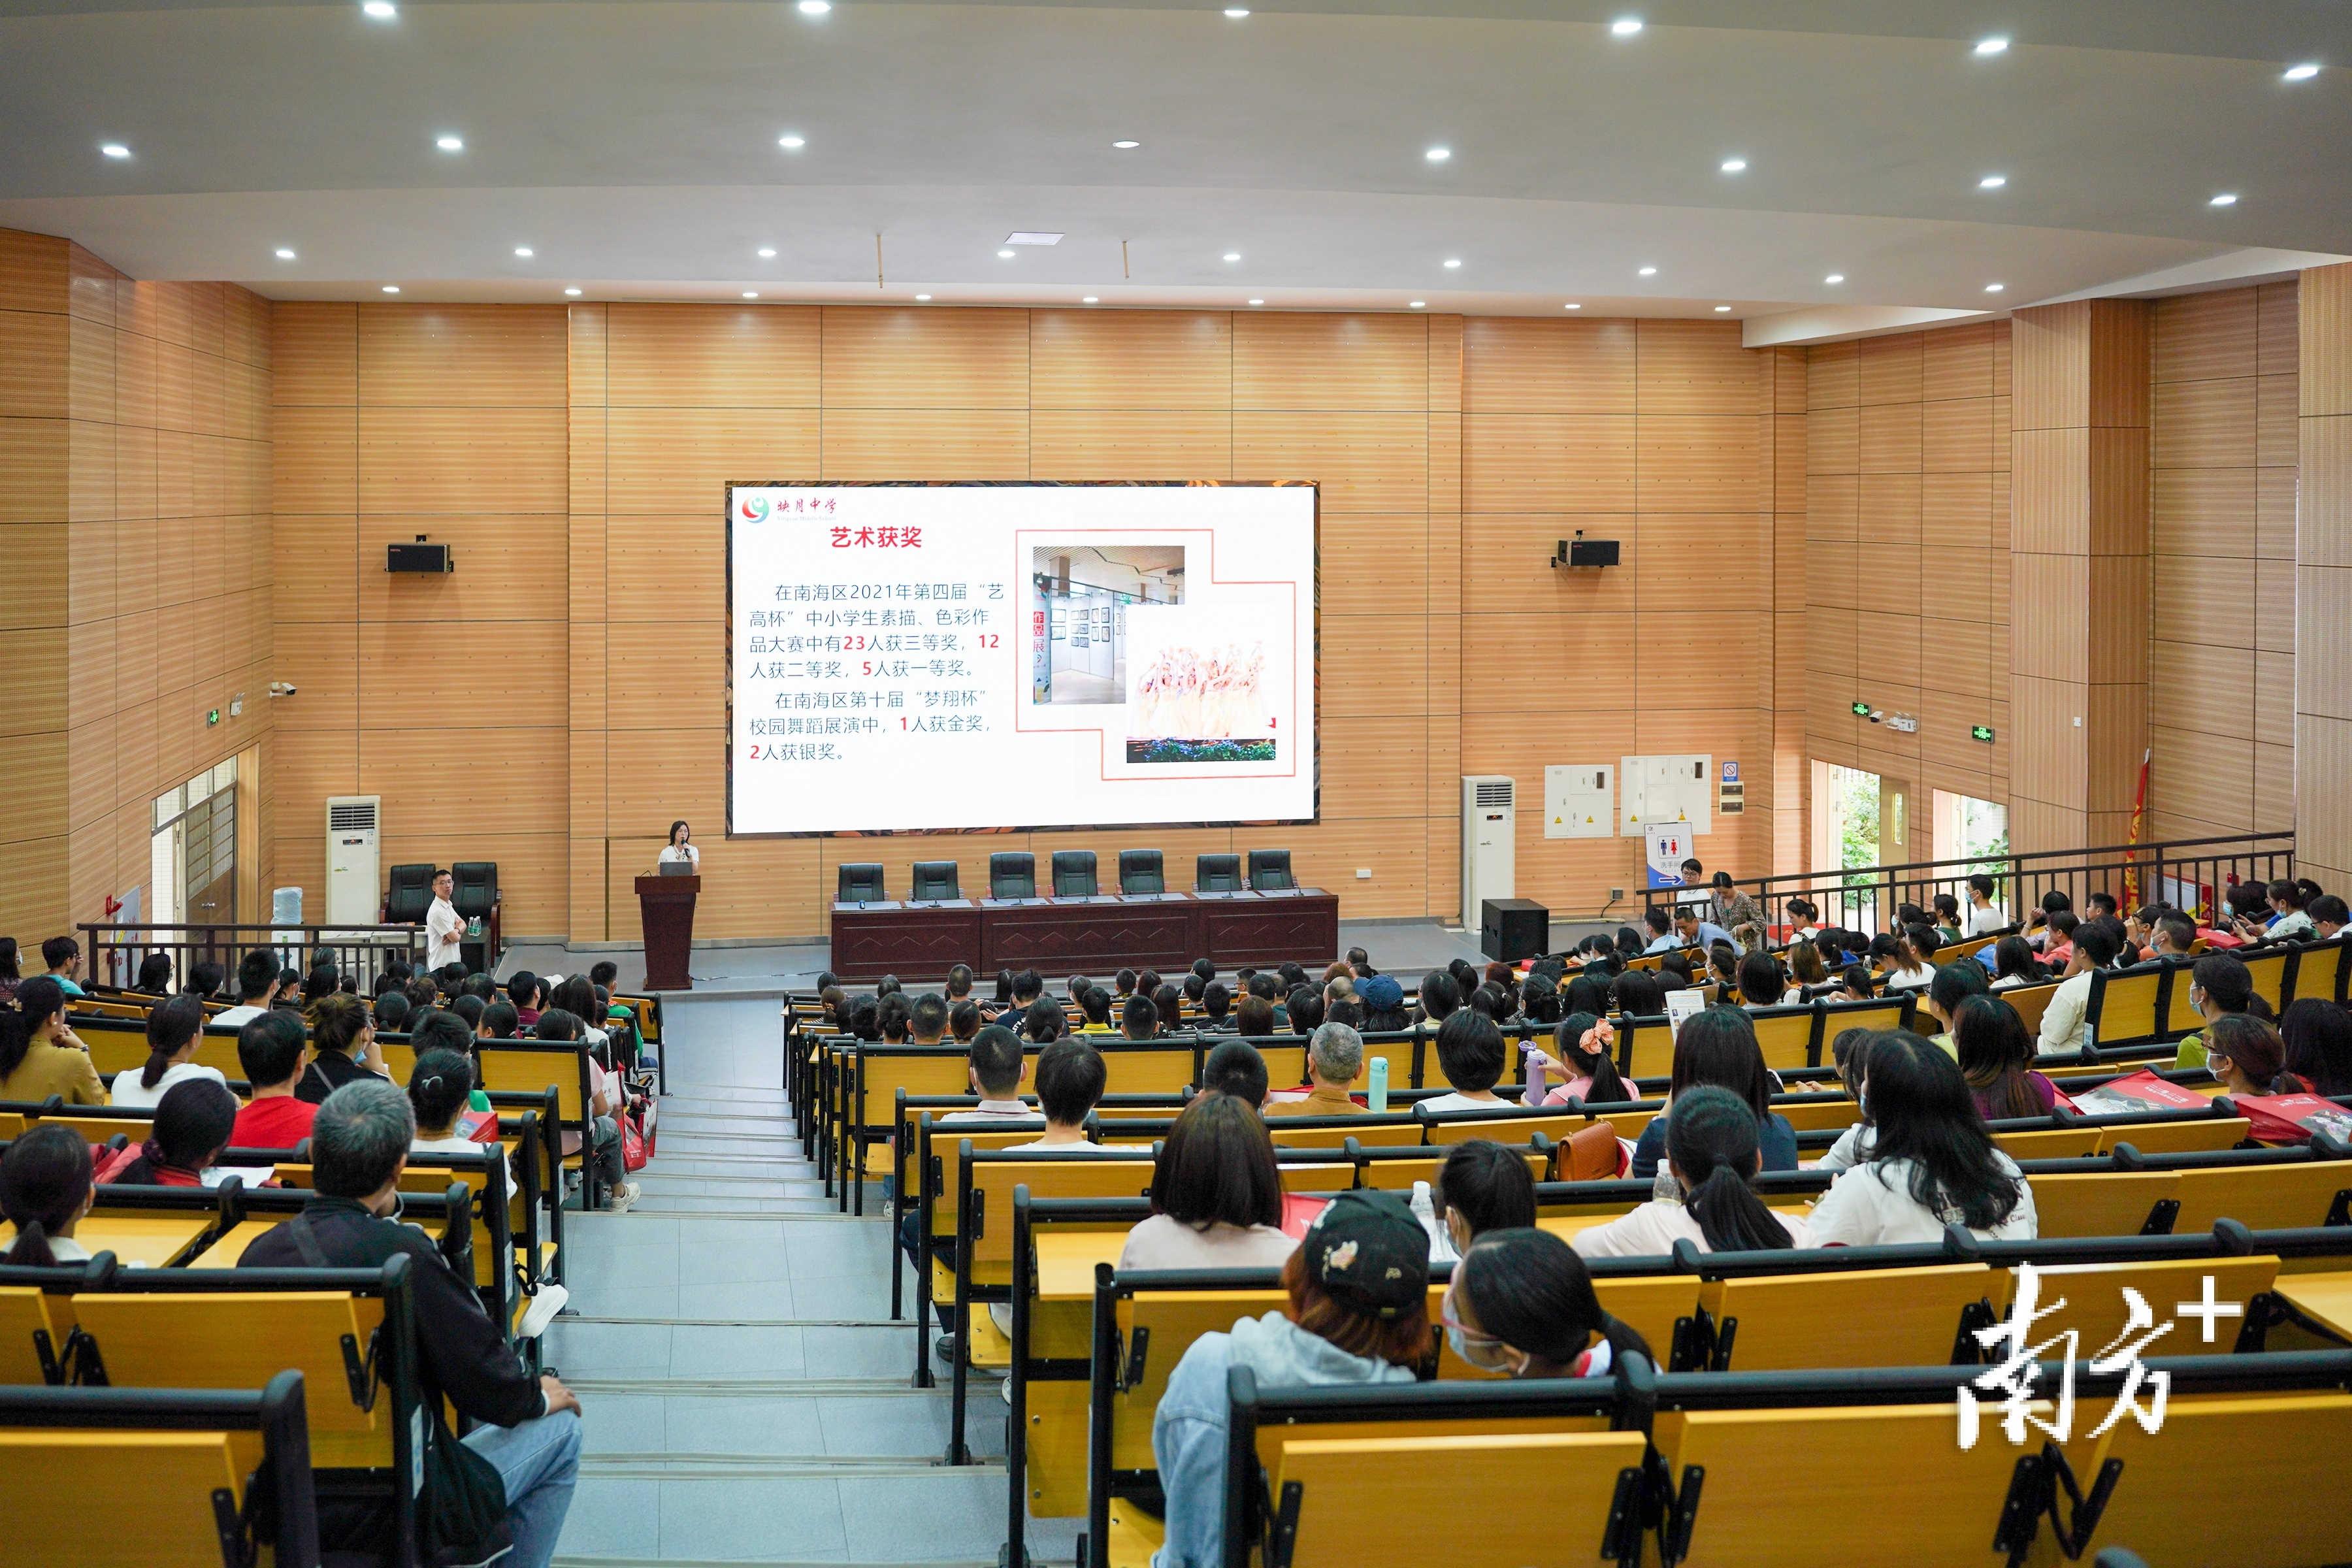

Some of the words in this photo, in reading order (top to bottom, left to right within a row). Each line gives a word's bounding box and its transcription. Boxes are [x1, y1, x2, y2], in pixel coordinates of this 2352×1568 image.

[777, 497, 836, 514] 映月中学
[830, 527, 922, 548] 艺术获奖
[751, 743, 842, 760] 2人获银奖。
